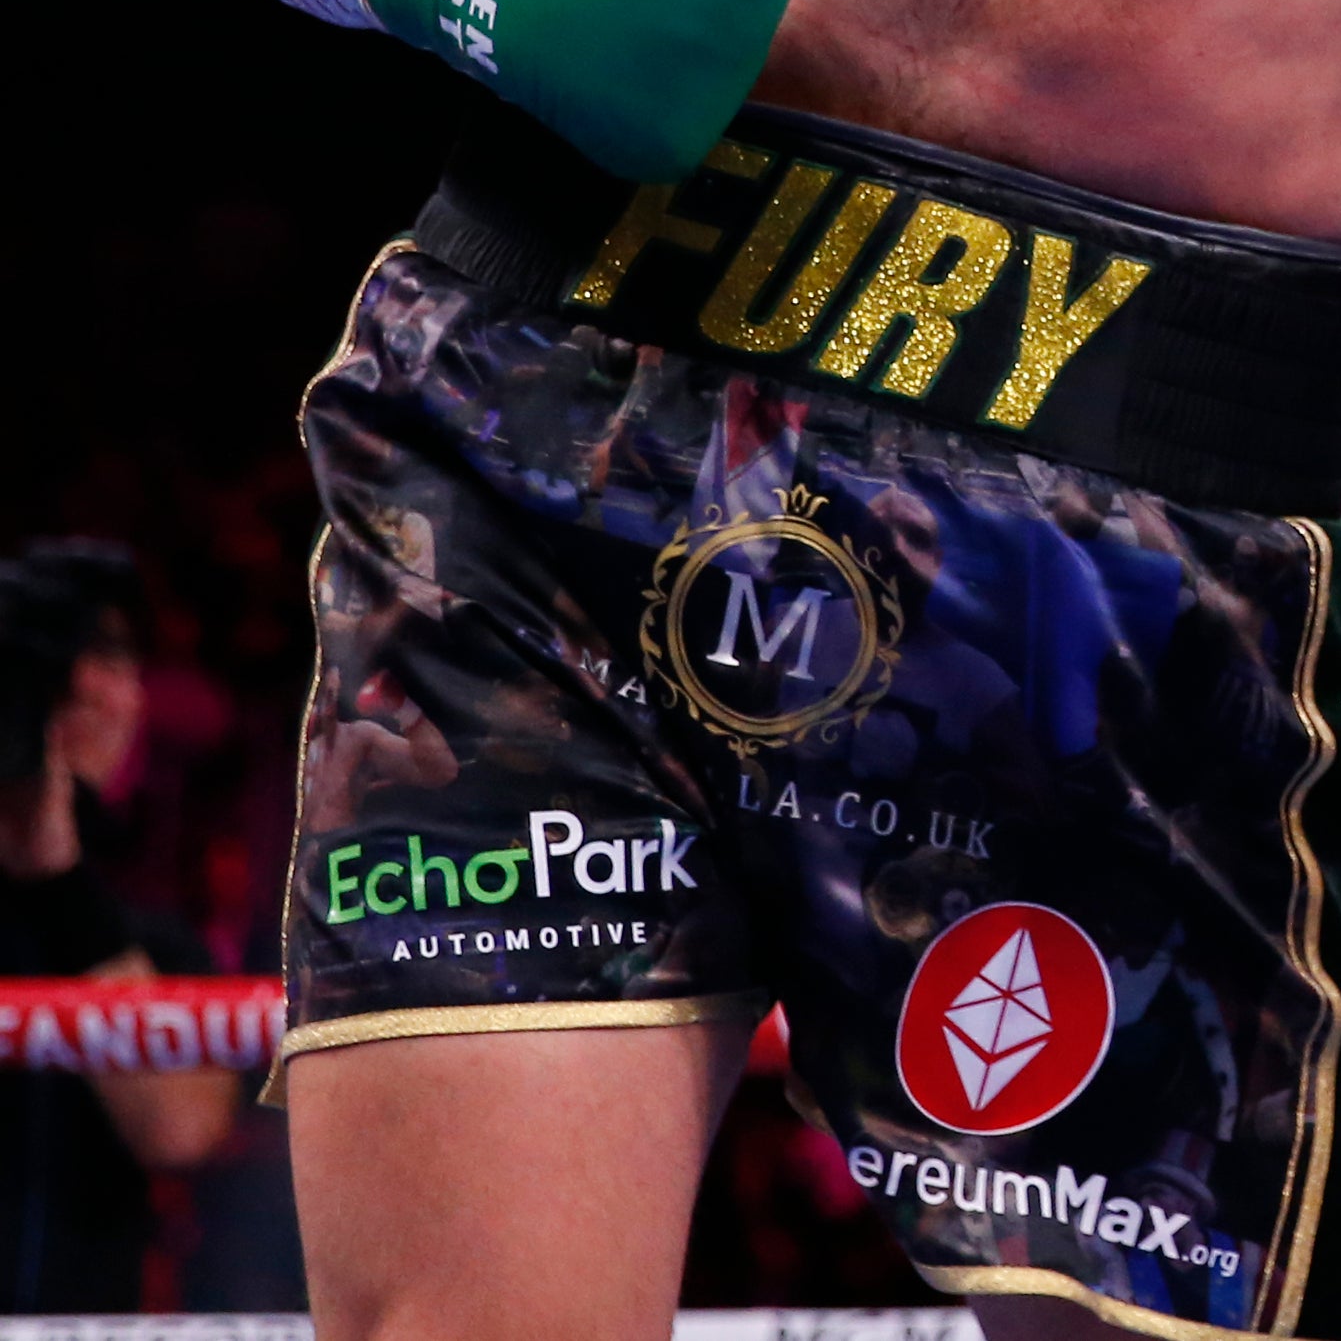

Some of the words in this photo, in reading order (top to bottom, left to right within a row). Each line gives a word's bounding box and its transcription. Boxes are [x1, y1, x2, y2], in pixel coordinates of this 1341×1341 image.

[568, 139, 1152, 430] FURY
[706, 570, 831, 681] M
[325, 809, 699, 925] EchoPark
[392, 920, 648, 962] AUTOMOTIVE
[848, 1144, 1241, 1278] ereumMax.org
